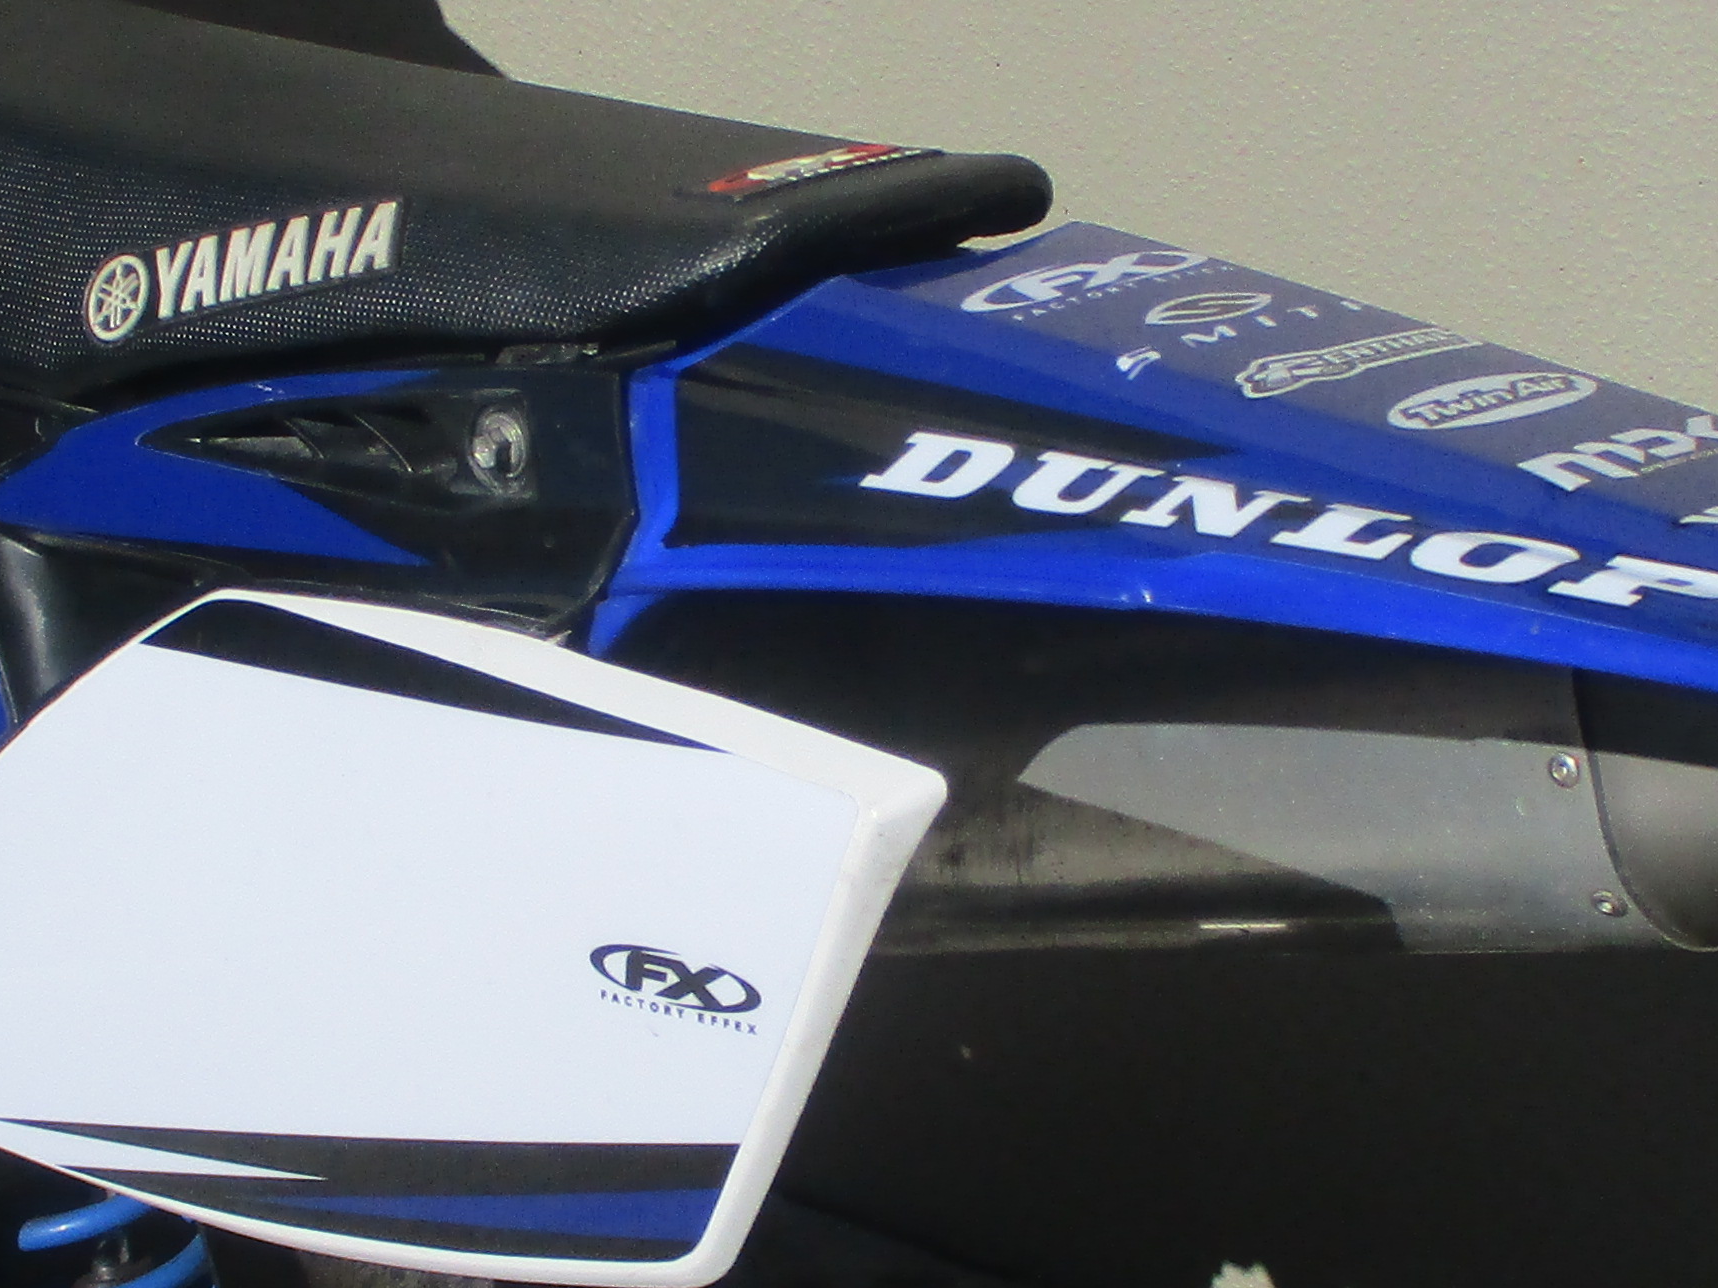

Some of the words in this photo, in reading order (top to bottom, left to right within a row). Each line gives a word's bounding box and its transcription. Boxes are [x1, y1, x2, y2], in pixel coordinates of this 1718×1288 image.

[155, 200, 398, 320] YAMAHA
[1408, 389, 1515, 422] Twin
[1515, 375, 1568, 398] Air
[600, 989, 685, 1020] FACTORY
[697, 1012, 758, 1036] EFFEX
